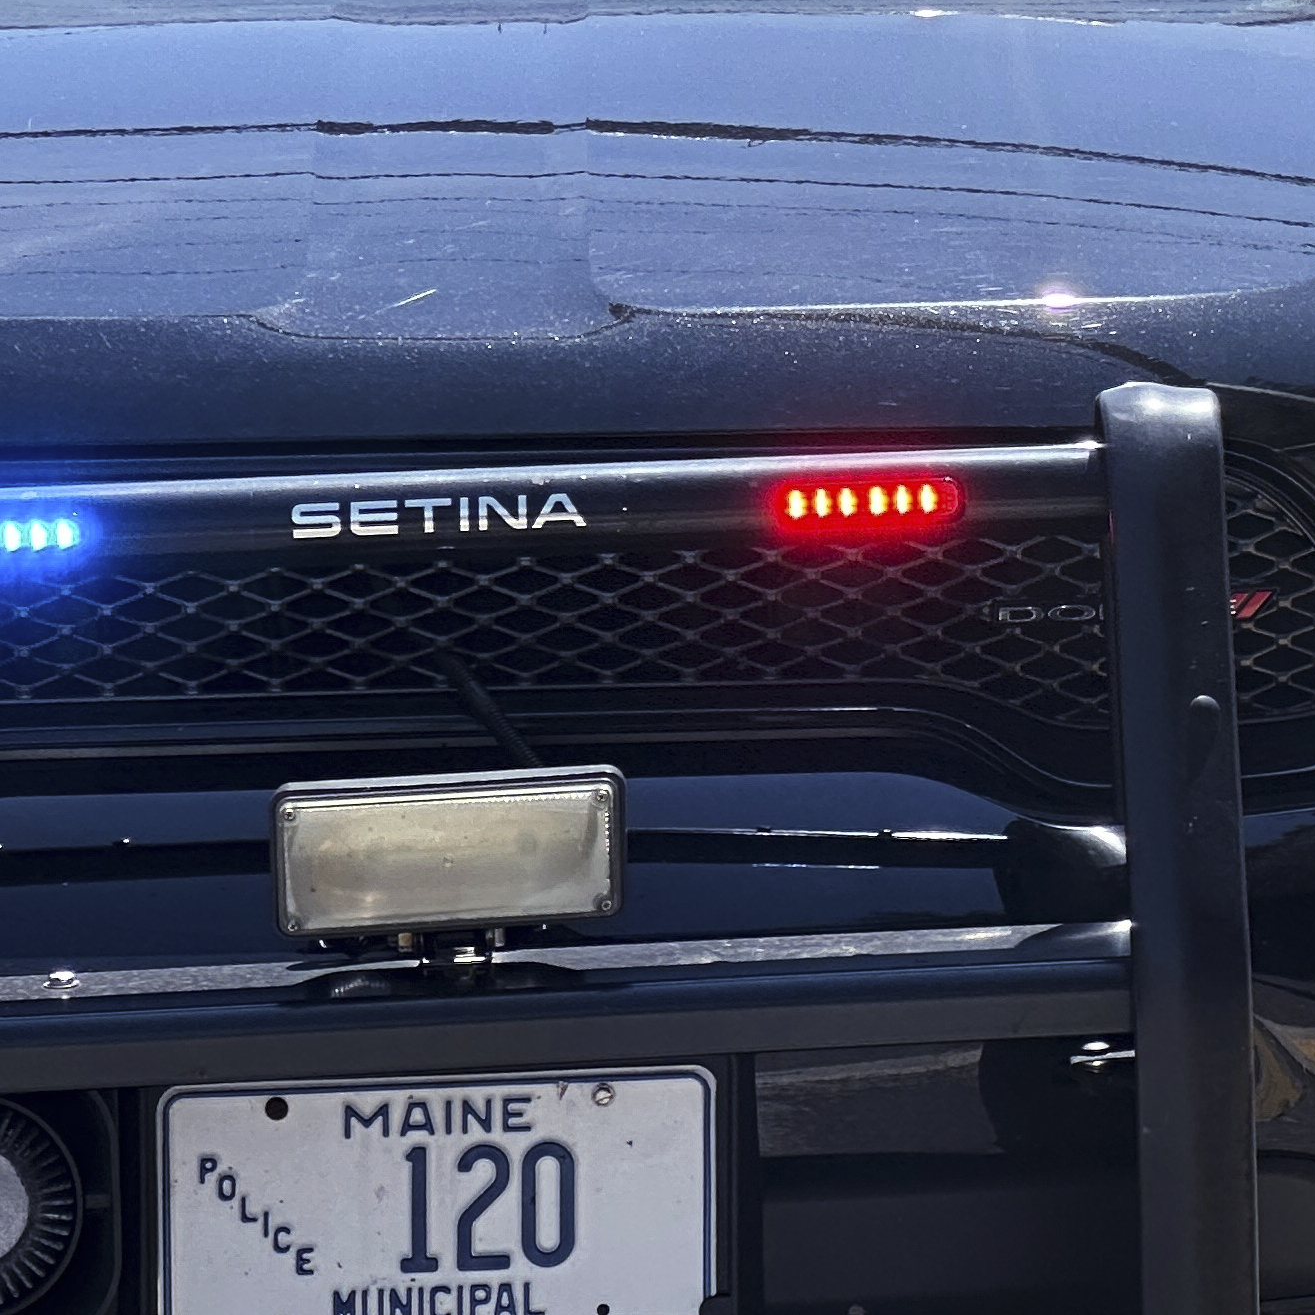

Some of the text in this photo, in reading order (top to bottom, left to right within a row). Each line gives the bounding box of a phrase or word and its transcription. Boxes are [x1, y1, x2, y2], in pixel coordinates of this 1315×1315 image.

[291, 492, 587, 539] SETINA
[344, 1097, 532, 1139] MAINE
[200, 1157, 314, 1276] POLICE
[400, 1141, 575, 1273] 120
[333, 1282, 546, 1315] MUNICIPAL
